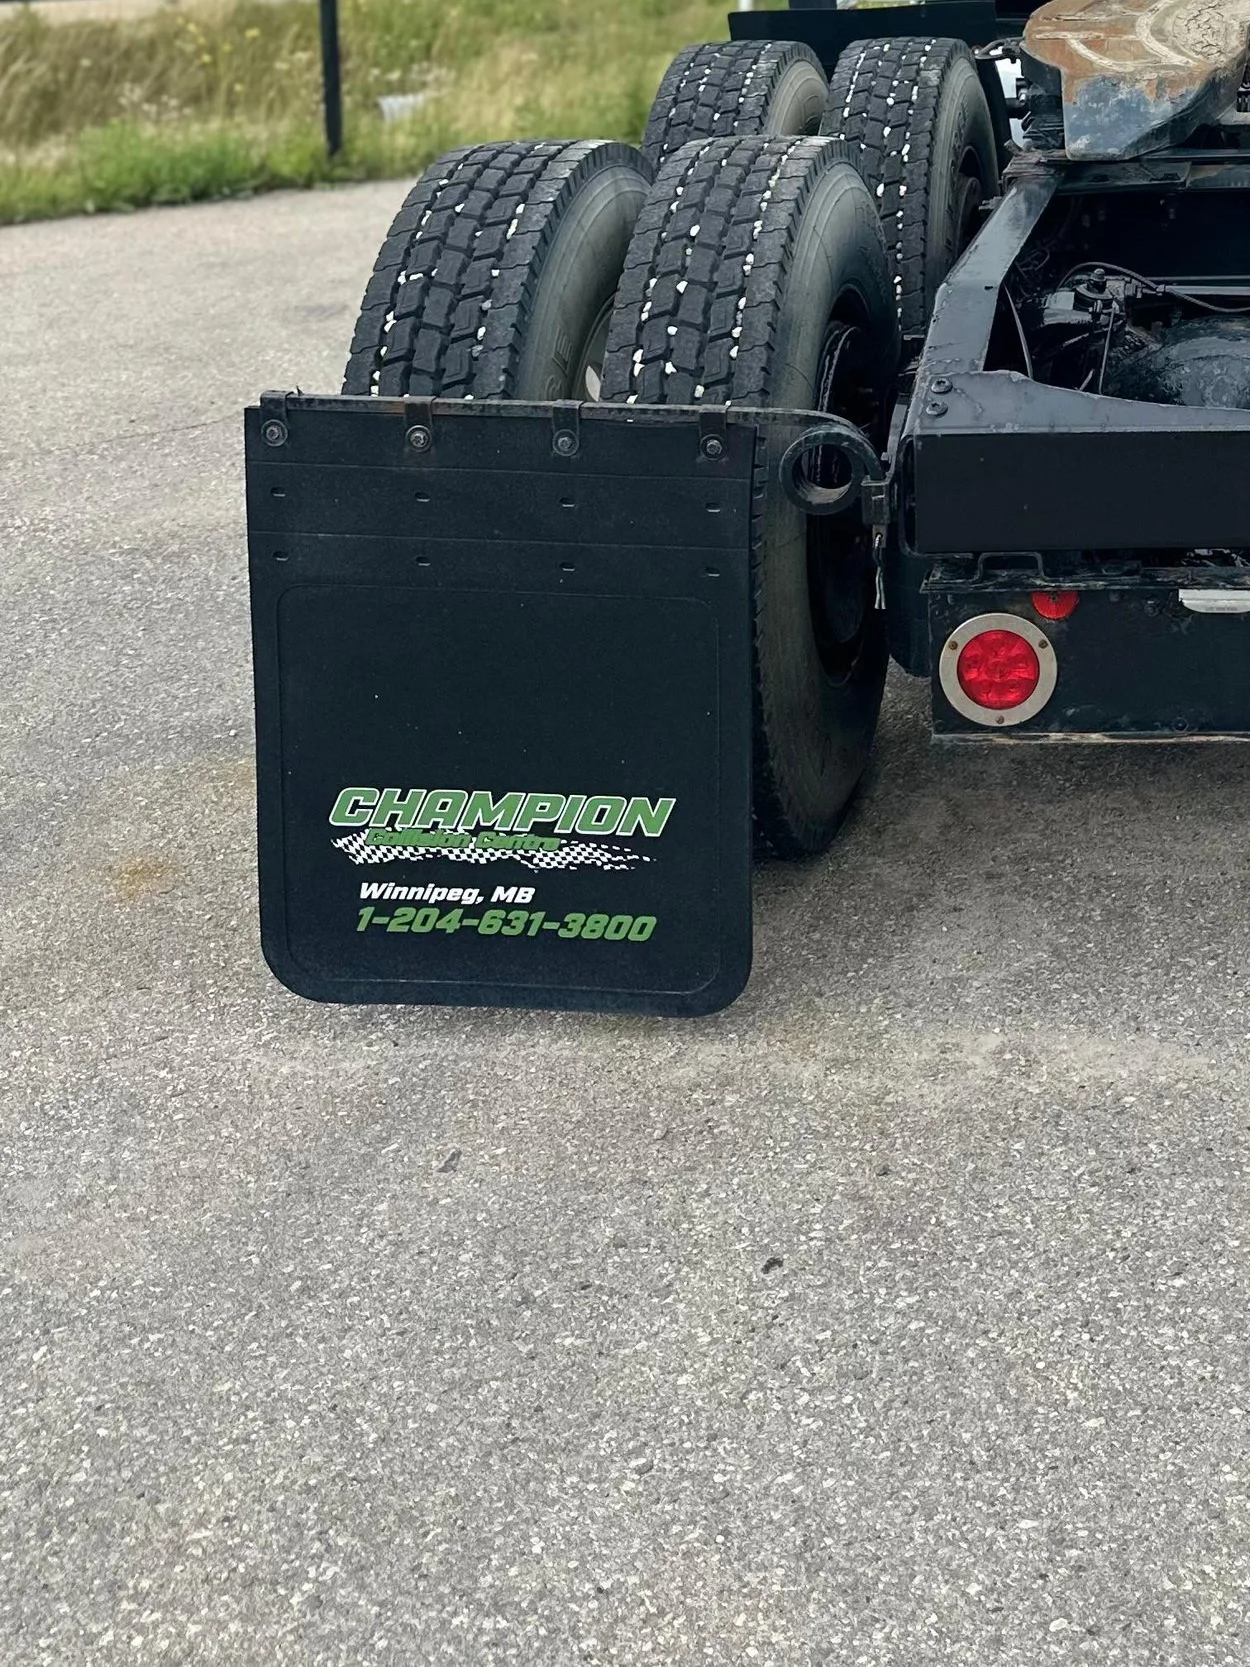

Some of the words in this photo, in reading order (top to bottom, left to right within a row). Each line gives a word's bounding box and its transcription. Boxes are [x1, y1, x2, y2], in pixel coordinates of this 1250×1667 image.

[329, 787, 676, 837] CHAMPION
[365, 827, 472, 849] Collision
[359, 882, 484, 905] Winnipeg,
[490, 886, 535, 904] MB
[356, 906, 657, 942] 1-204-631-3800
